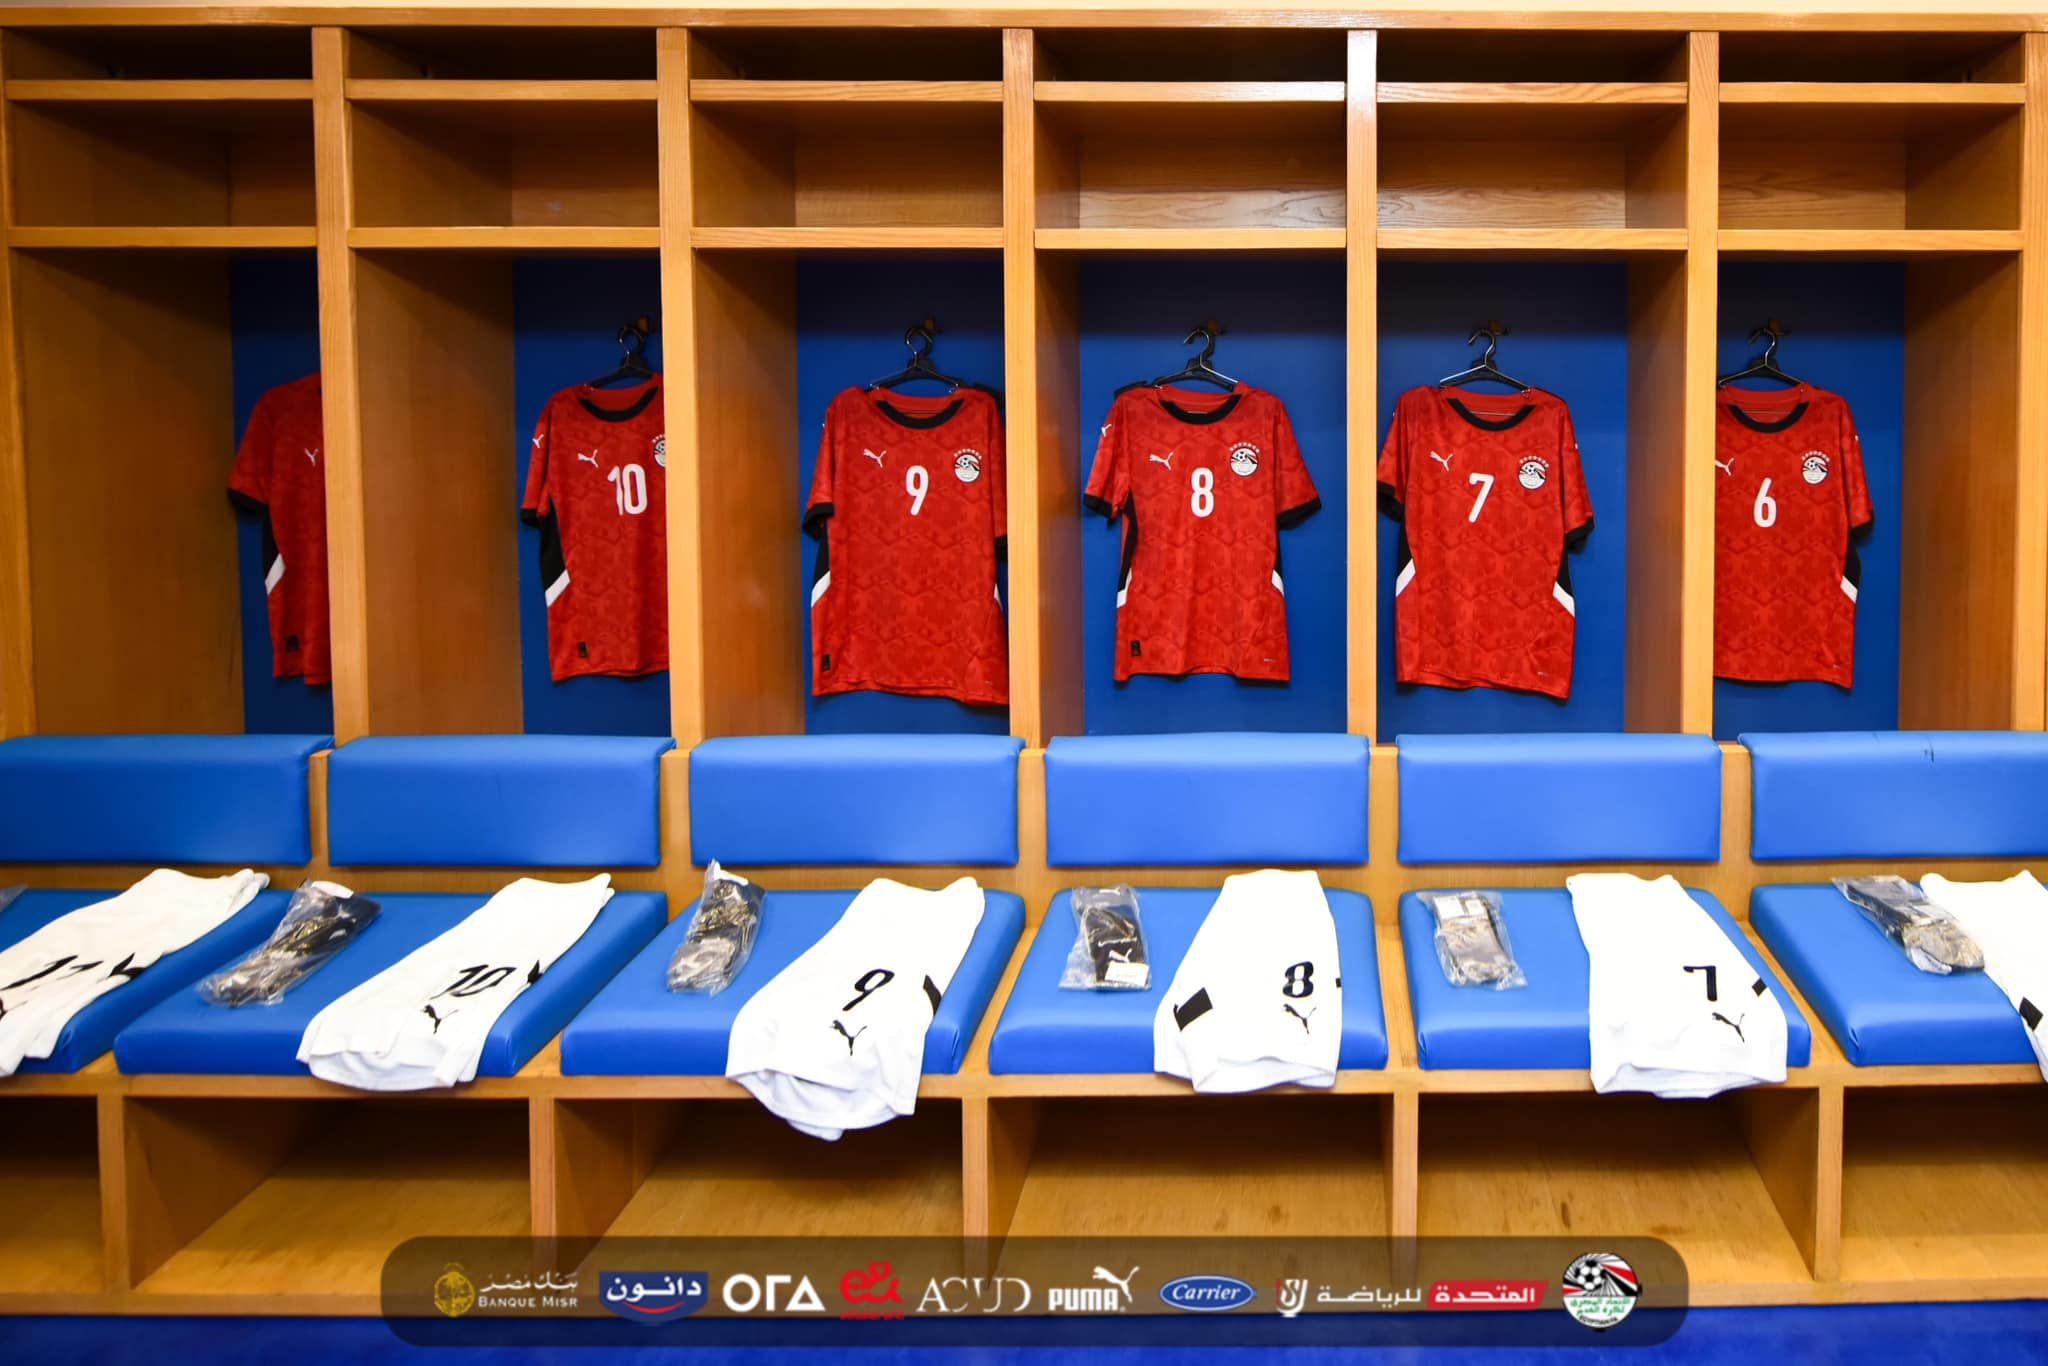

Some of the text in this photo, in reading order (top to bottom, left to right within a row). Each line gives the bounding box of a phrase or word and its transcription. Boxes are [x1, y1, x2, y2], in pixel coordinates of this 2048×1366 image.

[607, 463, 648, 516] 10
[905, 465, 929, 516] 9
[1190, 467, 1215, 518] 8
[1468, 472, 1495, 523] 7
[1753, 477, 1777, 528] 6
[432, 964, 517, 999] 10
[842, 968, 895, 1012] 9
[1282, 961, 1315, 999] 8
[1683, 965, 1718, 1002] 7
